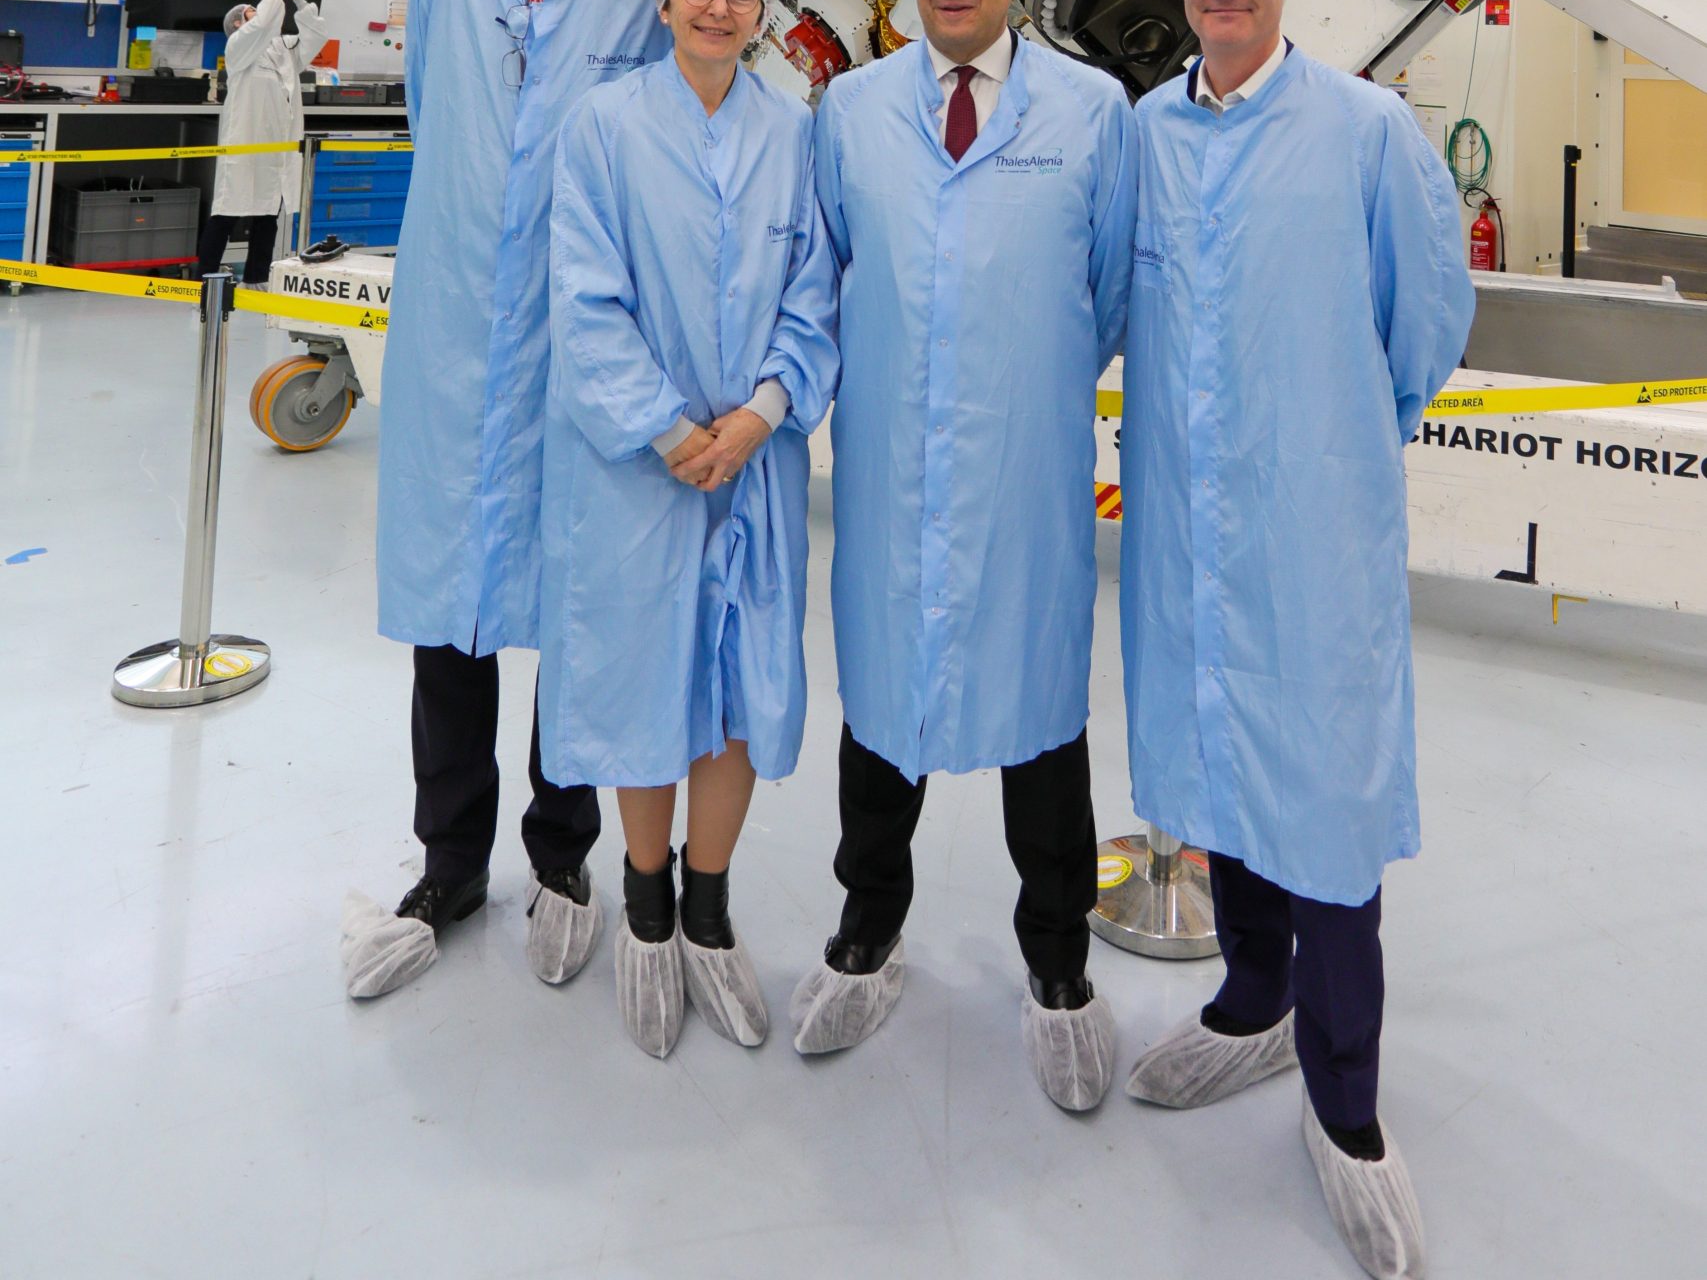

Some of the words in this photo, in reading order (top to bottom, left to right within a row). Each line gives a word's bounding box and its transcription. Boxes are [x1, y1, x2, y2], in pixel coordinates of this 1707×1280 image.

[995, 155, 1063, 167] ThalesAlenia
[157, 285, 169, 294] ESD
[283, 275, 350, 299] MASSE
[357, 284, 370, 302] A
[377, 286, 391, 304] V
[1653, 389, 1668, 397] ESD
[1670, 385, 1707, 396] PROTECTE
[1427, 399, 1459, 408] ECTED
[1462, 398, 1483, 407] AREA
[1577, 440, 1707, 480] HORIZ
